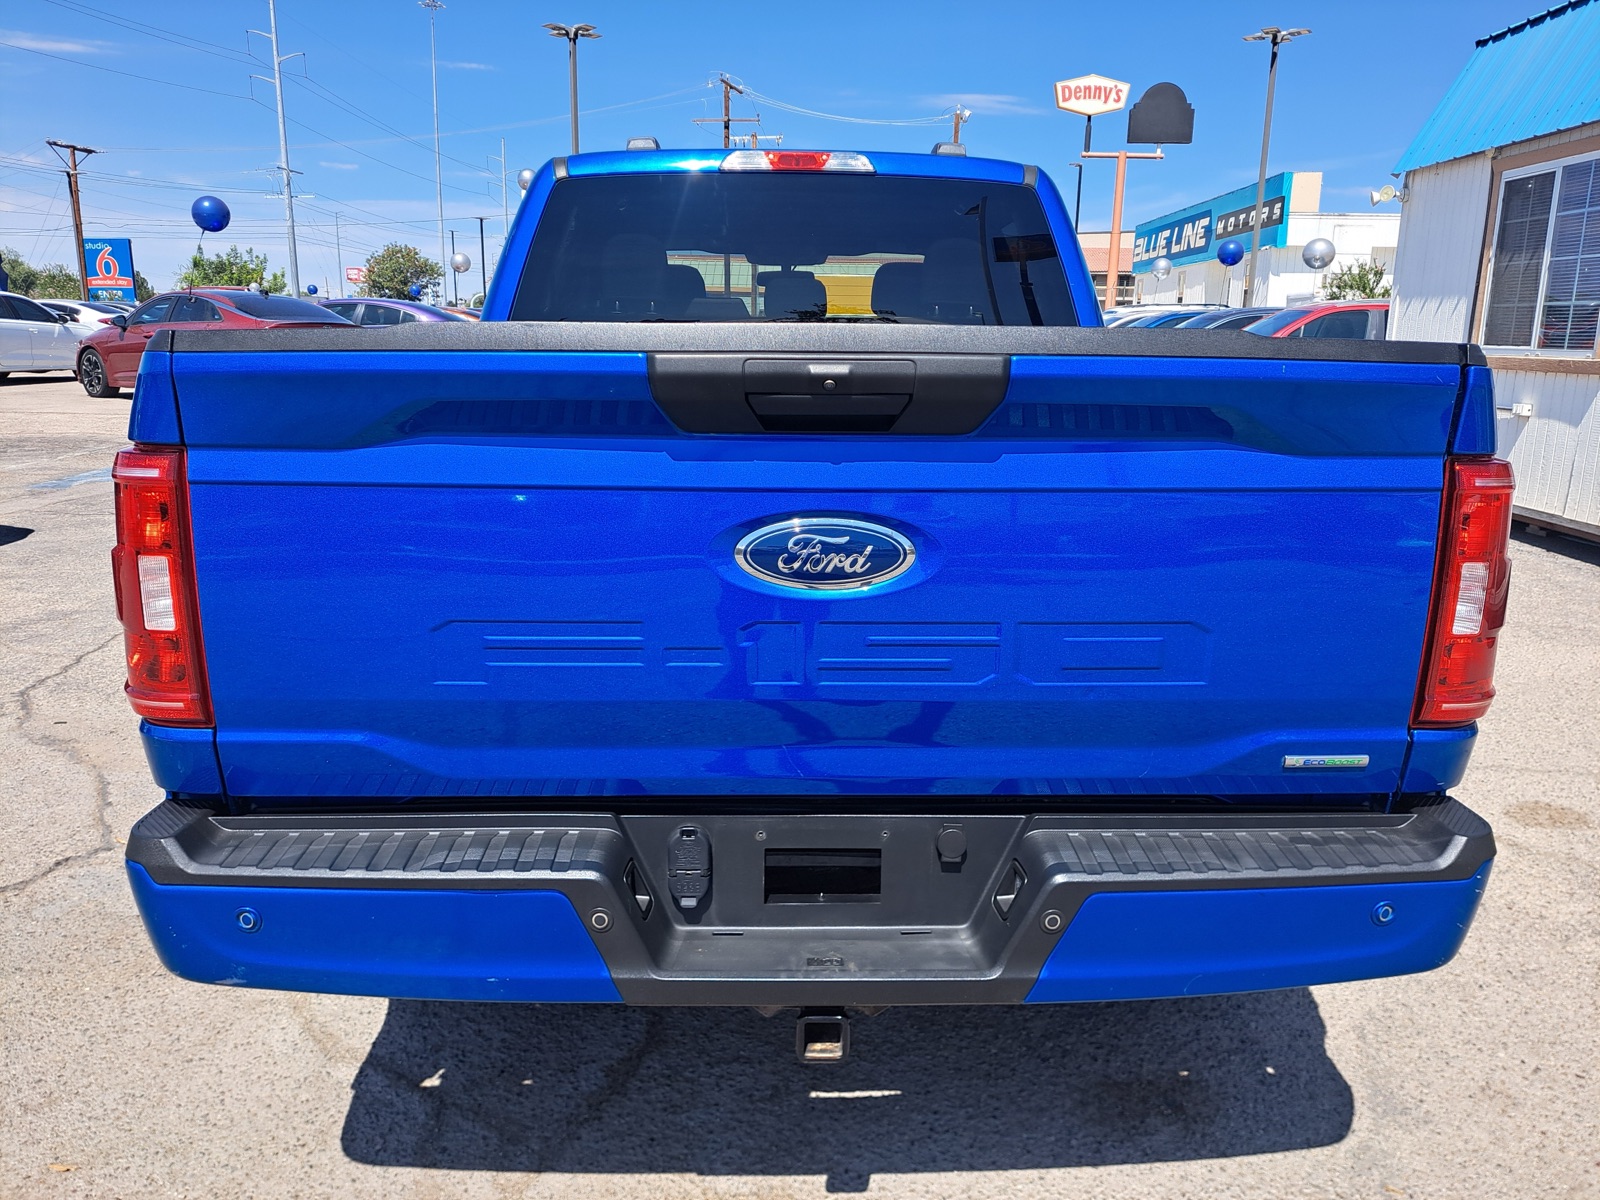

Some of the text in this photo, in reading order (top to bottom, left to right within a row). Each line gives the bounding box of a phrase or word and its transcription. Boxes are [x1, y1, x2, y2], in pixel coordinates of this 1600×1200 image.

[1060, 83, 1123, 104] Denny's
[1216, 202, 1282, 235] MOTORS
[85, 242, 109, 250] studio
[1133, 216, 1211, 262] BLUE LINE
[96, 247, 119, 278] 6
[98, 290, 123, 298] ENER
[777, 533, 874, 574] Ford
[429, 619, 1212, 687] F-150
